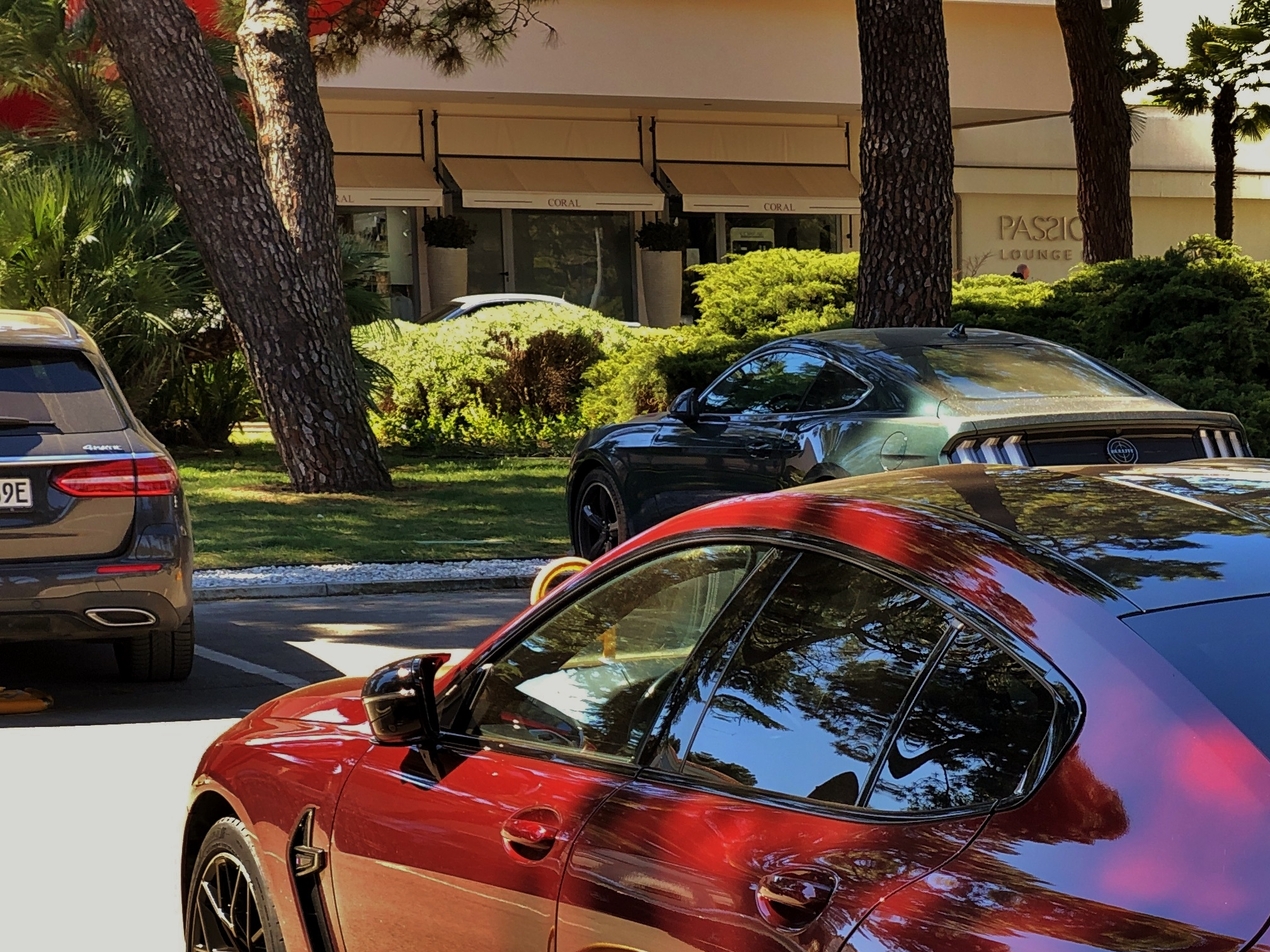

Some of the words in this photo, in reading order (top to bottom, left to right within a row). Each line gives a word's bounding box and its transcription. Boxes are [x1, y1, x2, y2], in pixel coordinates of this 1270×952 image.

[335, 194, 354, 203] RAL
[547, 198, 581, 207] CORAL
[763, 203, 796, 212] CORAL
[999, 215, 1083, 241] PASSIO
[1001, 249, 1072, 260] LOUNGE
[0, 481, 28, 503] 9E
